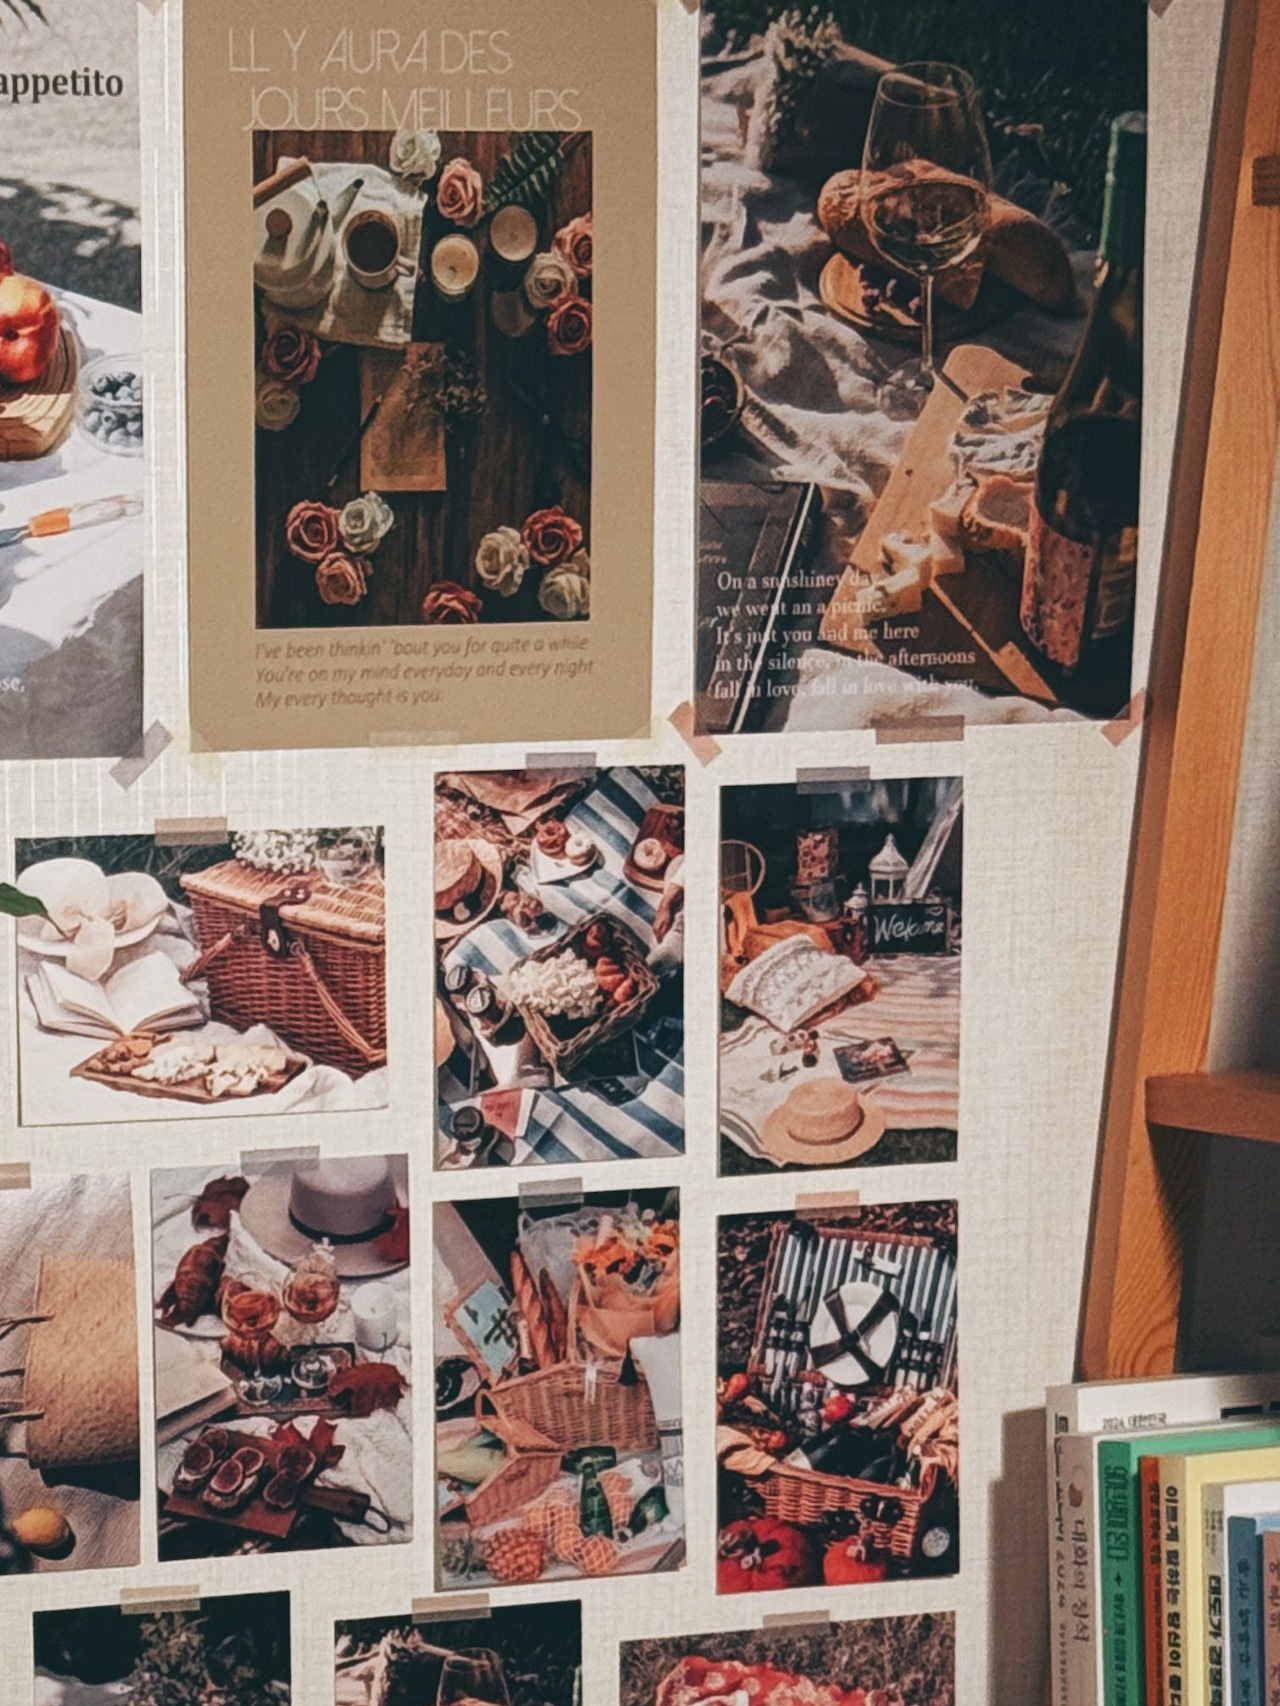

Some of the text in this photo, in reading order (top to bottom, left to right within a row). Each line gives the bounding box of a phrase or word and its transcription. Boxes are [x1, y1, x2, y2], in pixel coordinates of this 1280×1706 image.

[283, 28, 308, 72] Y
[320, 28, 428, 74] AURA
[440, 28, 513, 74] DES
[241, 86, 582, 133] JOURS MEILLEURS
[717, 571, 742, 590] On
[747, 577, 757, 589] a
[716, 605, 740, 618] we
[783, 629, 812, 648] you
[817, 626, 847, 642] and
[852, 629, 879, 641] me
[883, 622, 919, 640] here
[255, 642, 282, 660] I've
[286, 642, 324, 659] been
[433, 640, 460, 658] you
[464, 636, 488, 658] for
[491, 637, 531, 656] quite
[534, 639, 545, 651] a
[549, 635, 589, 652] while
[889, 648, 976, 667] afternoons
[256, 666, 304, 684] You're
[308, 668, 328, 682] on
[332, 668, 357, 685] my
[361, 663, 401, 680] mind
[476, 660, 507, 678] and
[509, 663, 551, 679] every
[553, 659, 594, 679] night
[255, 690, 280, 711] My
[284, 691, 326, 709] every
[331, 687, 393, 709] thought
[714, 680, 739, 699] fall
